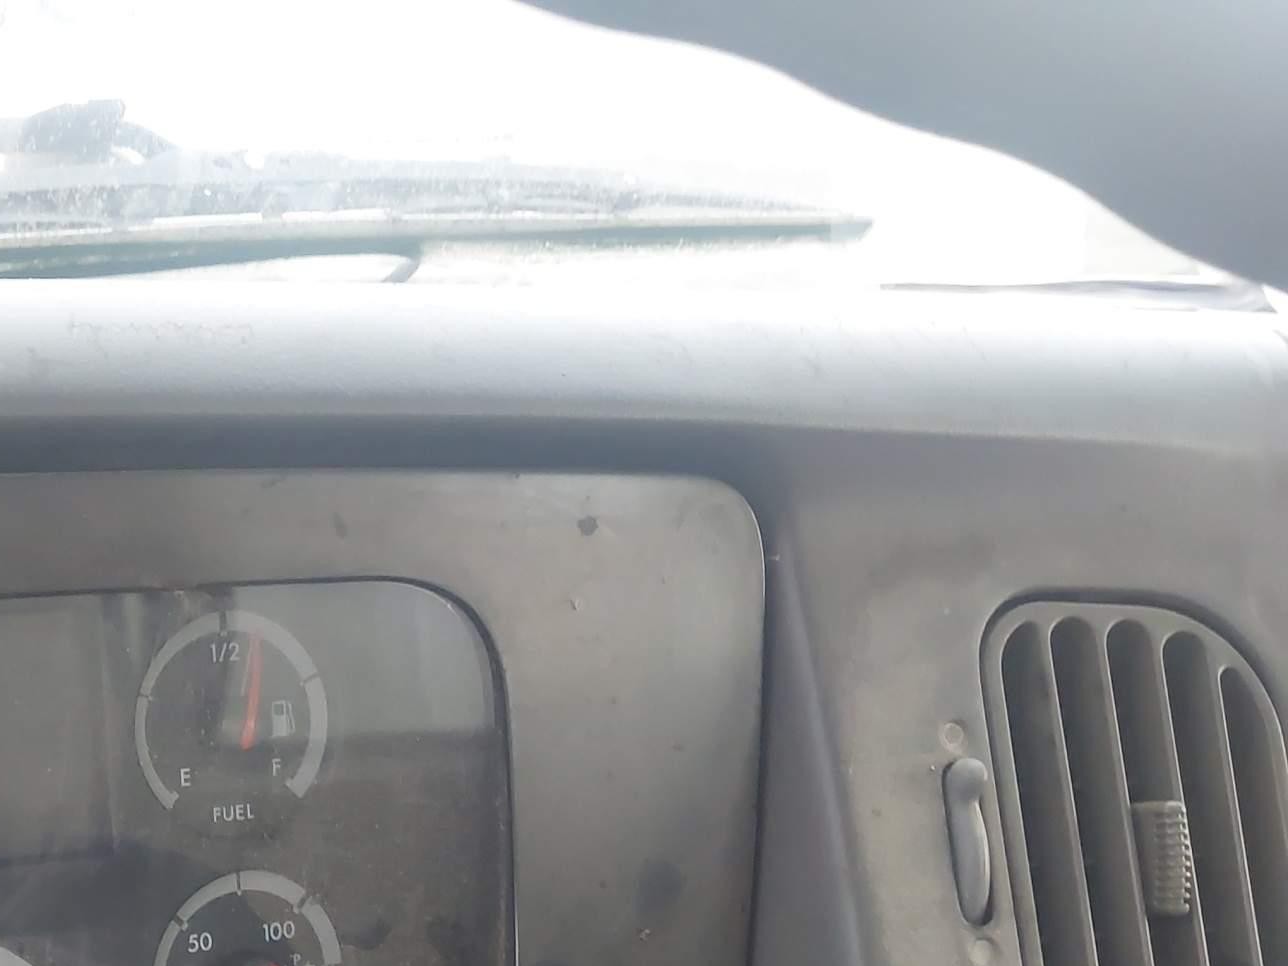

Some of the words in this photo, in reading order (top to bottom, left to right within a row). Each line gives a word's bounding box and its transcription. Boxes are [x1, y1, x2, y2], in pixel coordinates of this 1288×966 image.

[210, 642, 240, 663] 1/2
[180, 768, 191, 787] E
[272, 758, 282, 777] F
[213, 804, 254, 823] FUEL
[263, 920, 295, 942] 100
[188, 932, 212, 953] 50
